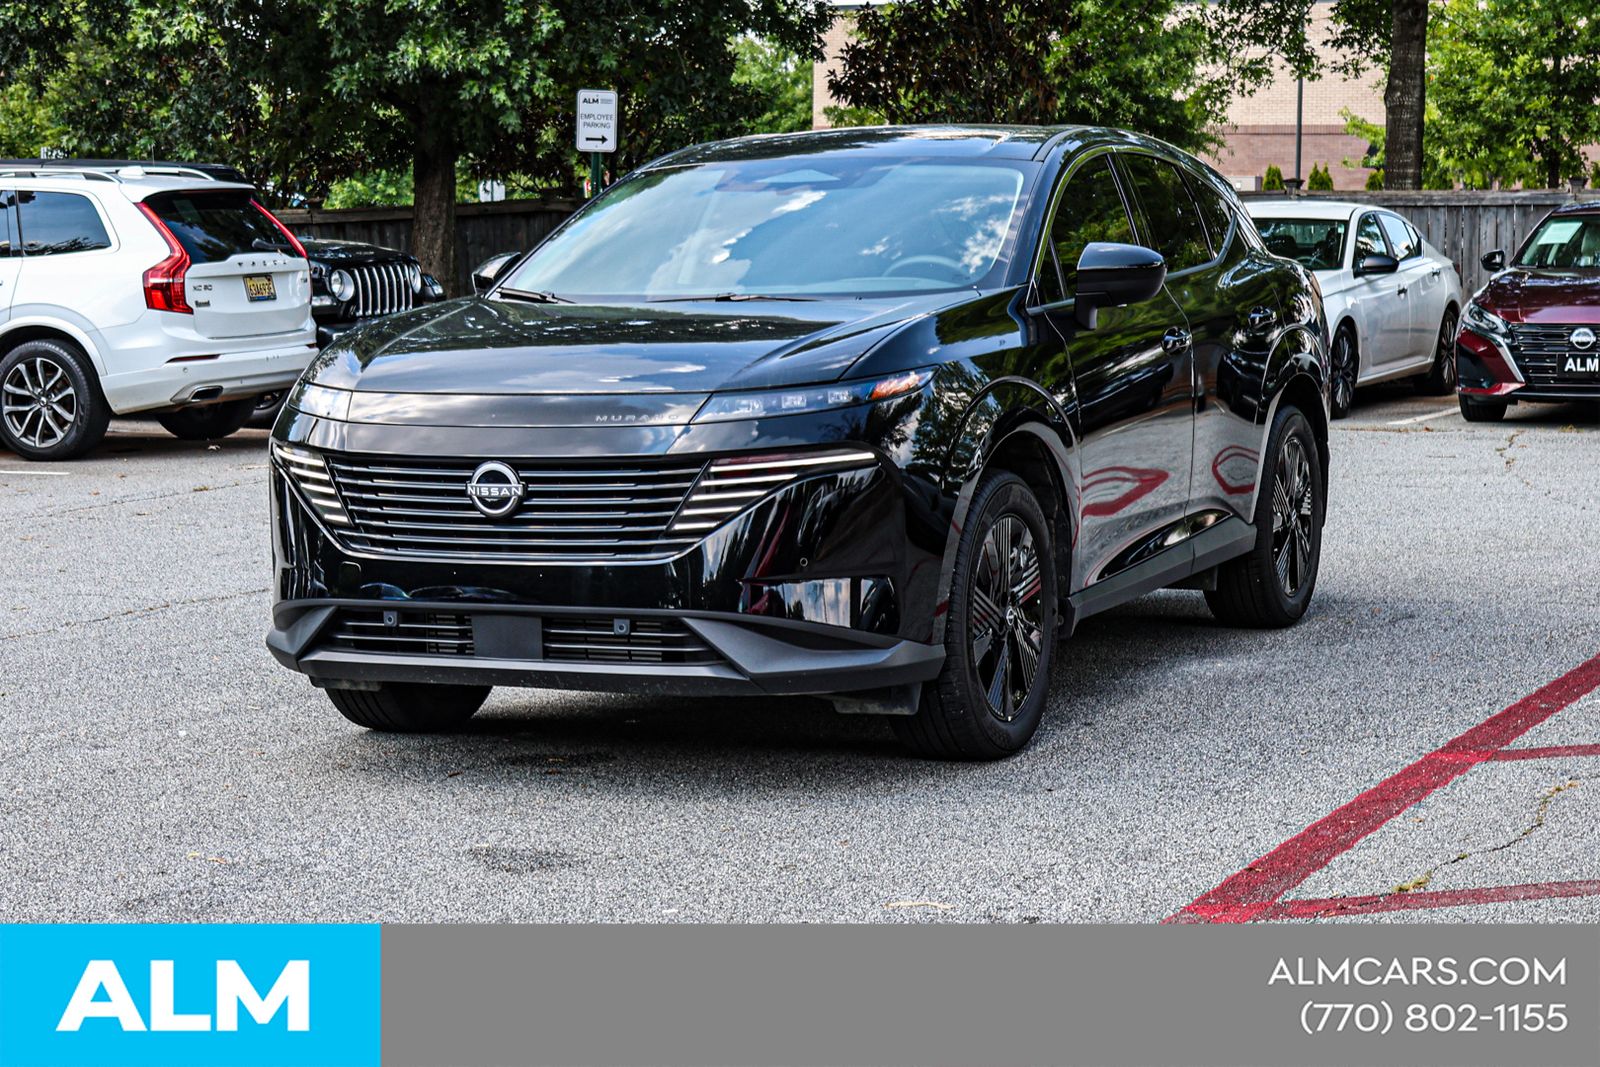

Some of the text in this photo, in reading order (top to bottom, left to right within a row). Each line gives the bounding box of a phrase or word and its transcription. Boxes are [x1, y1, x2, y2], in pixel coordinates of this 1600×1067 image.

[582, 97, 600, 105] ALM
[580, 113, 614, 121] EMPLOYEE
[583, 121, 612, 129] PARKING
[1564, 357, 1599, 372] ALM
[467, 486, 522, 497] NISSAN
